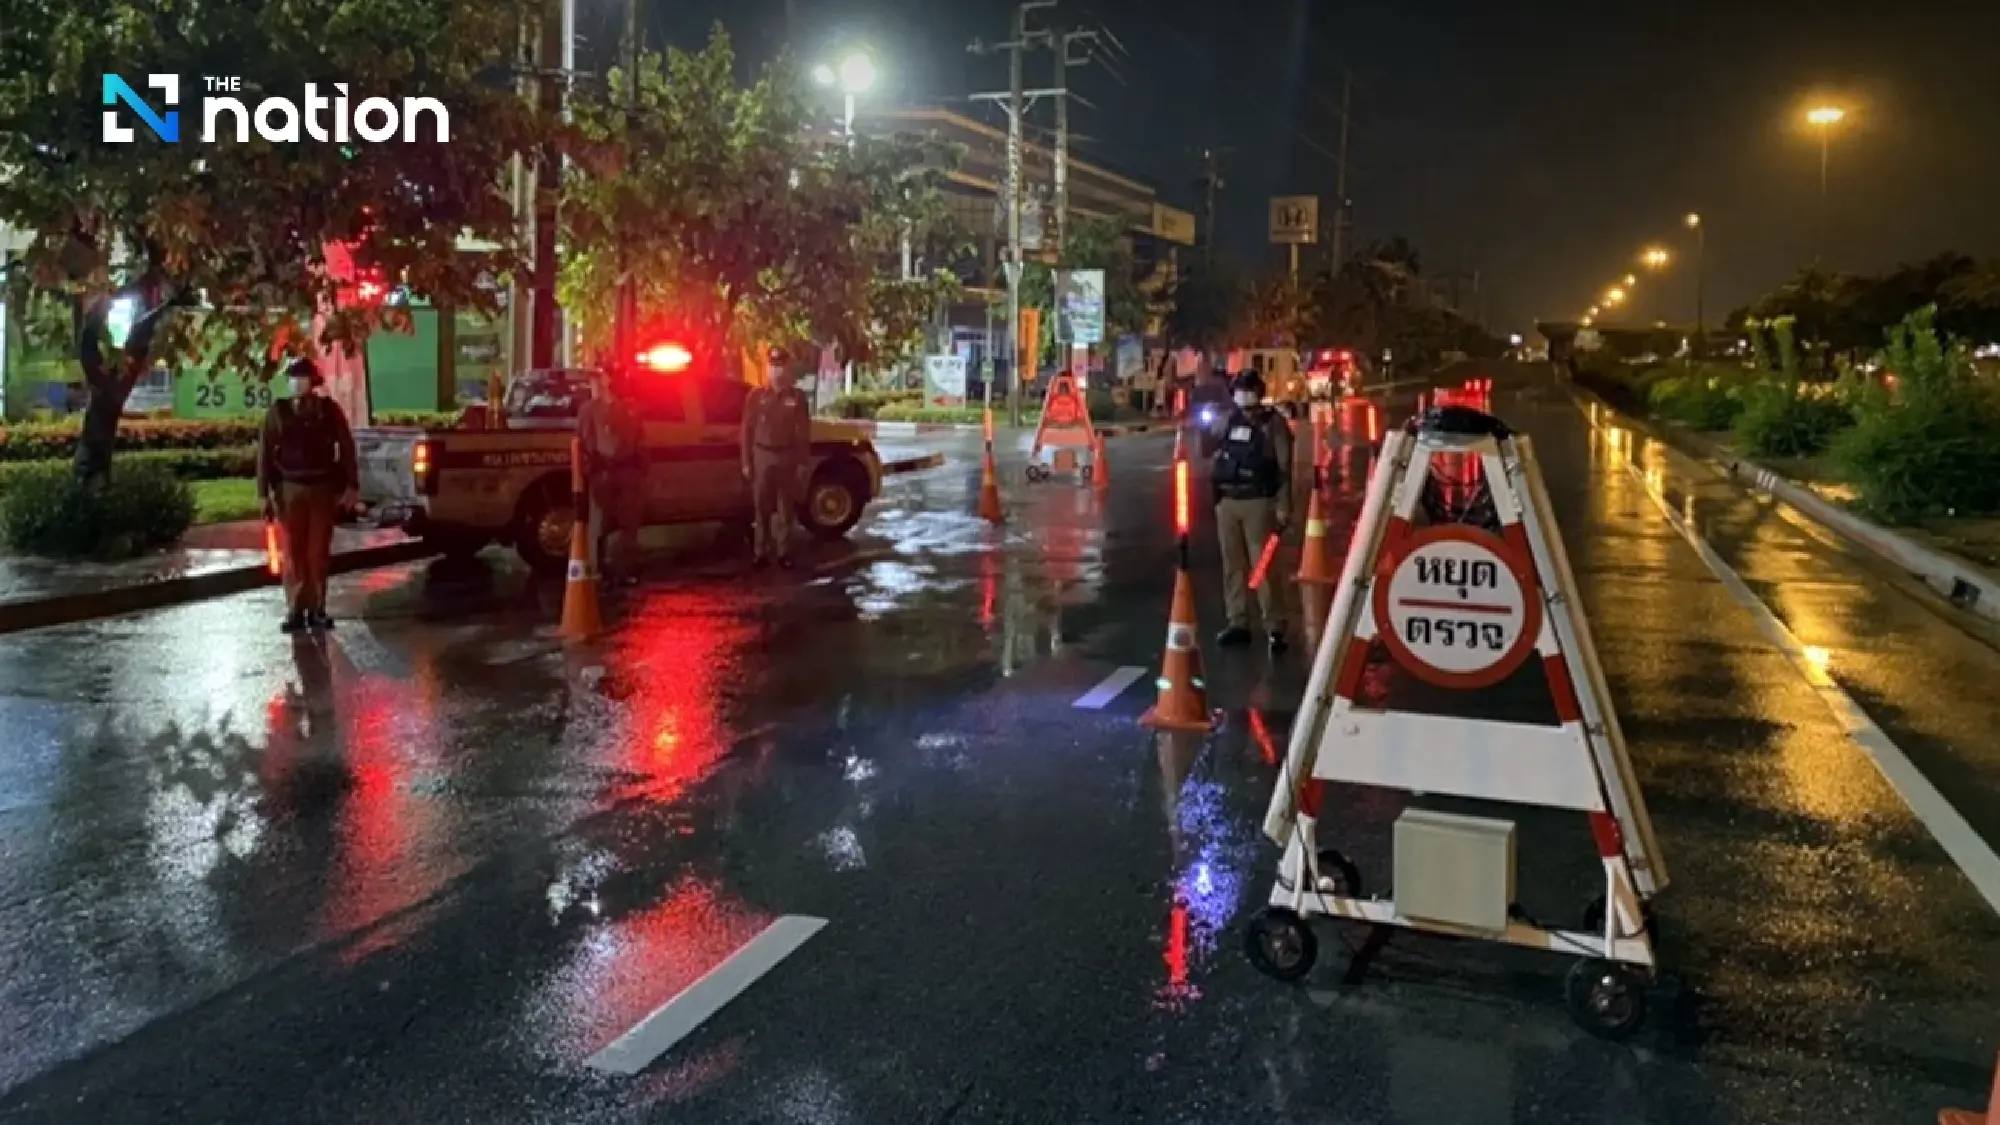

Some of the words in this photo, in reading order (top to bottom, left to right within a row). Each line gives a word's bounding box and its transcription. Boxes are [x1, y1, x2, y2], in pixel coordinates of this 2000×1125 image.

[196, 384, 226, 407] 25
[244, 384, 272, 408] 59
[1414, 556, 1498, 600] หยุด
[1406, 616, 1504, 650] ตรวจ
